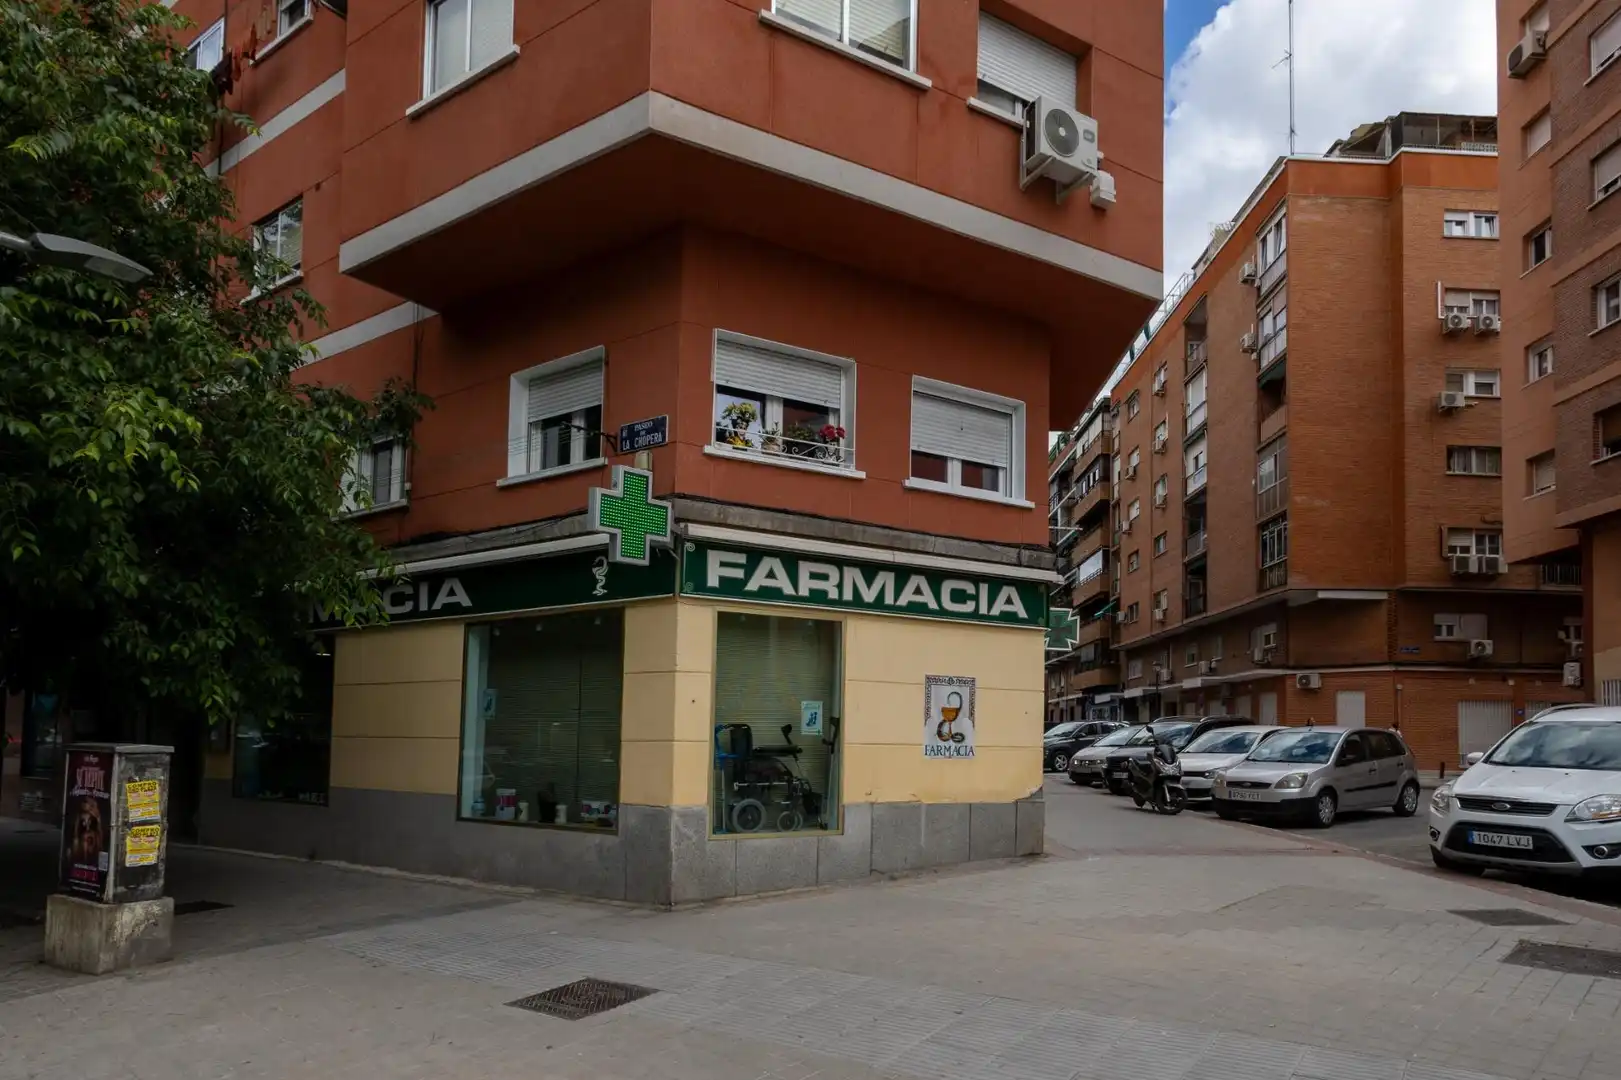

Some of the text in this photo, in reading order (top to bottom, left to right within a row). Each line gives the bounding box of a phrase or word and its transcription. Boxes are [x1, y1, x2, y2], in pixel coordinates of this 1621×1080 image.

[634, 421, 653, 431] PASEO
[622, 432, 662, 450] LA CHOPERA
[706, 550, 1028, 619] FARMACIA
[924, 744, 975, 757] FARMACIA
[1477, 833, 1530, 847] 1047 LVJ
